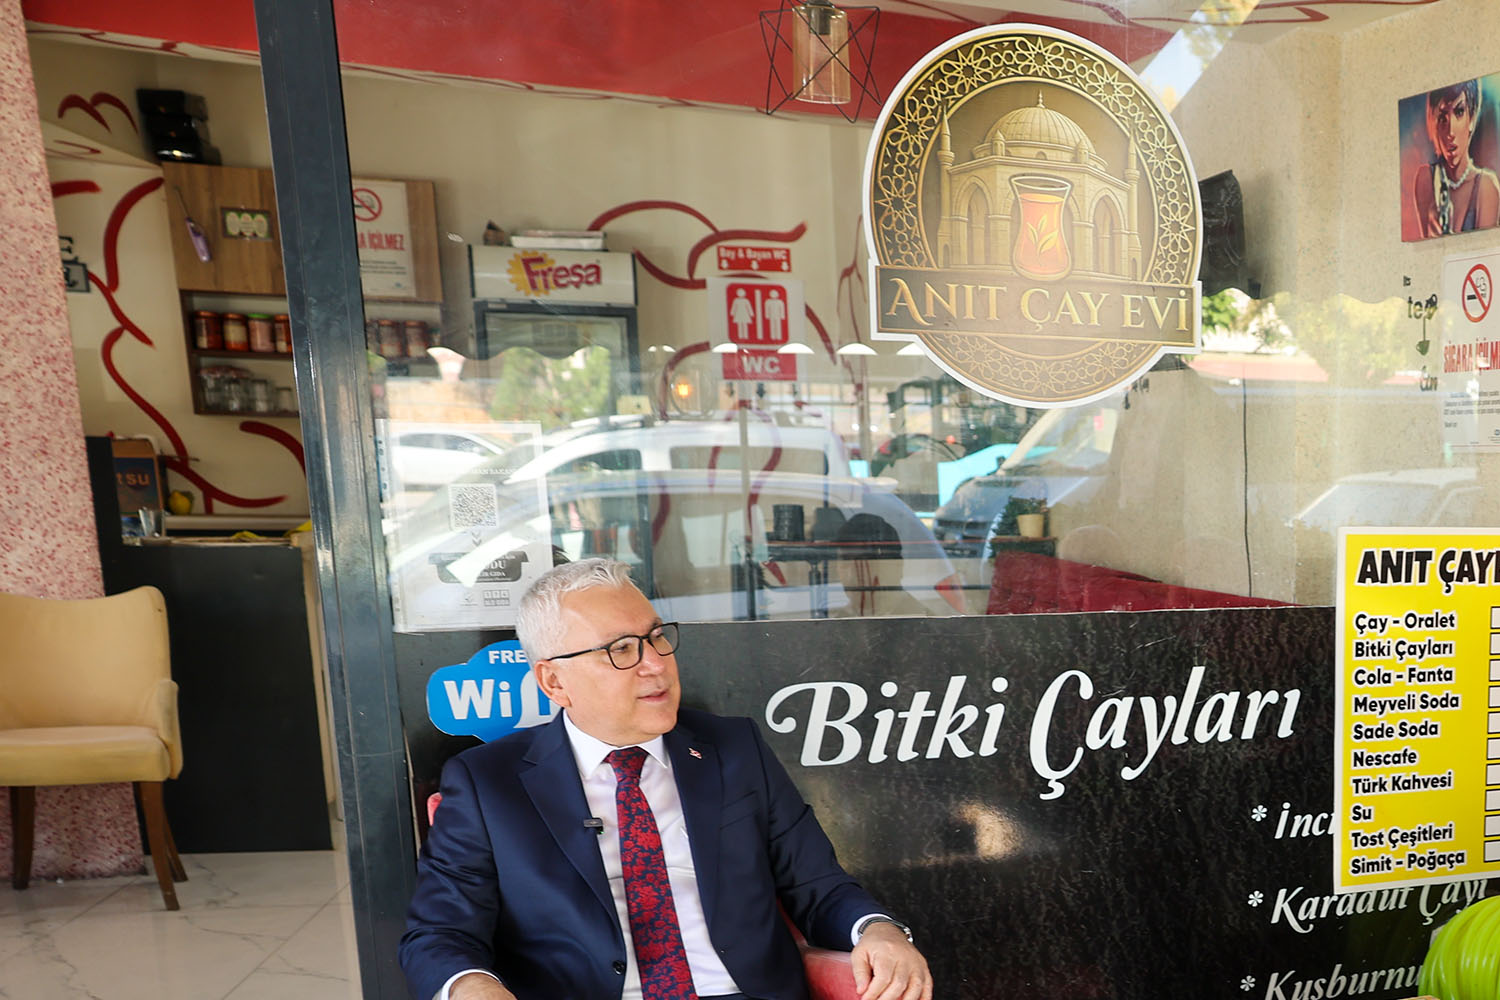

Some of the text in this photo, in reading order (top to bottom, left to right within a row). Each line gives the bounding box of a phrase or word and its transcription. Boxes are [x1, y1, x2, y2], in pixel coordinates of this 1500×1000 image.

[520, 256, 602, 290] Freşa
[885, 277, 1190, 332] ANIT ÇAY EVİ
[741, 355, 780, 374] WC
[1443, 340, 1474, 374] SİGARA
[1357, 550, 1433, 585] ANIT
[1355, 613, 1389, 635] Çay
[1404, 611, 1456, 629] Oralet
[1354, 638, 1453, 660] Bitki Çayları
[1354, 668, 1392, 686] Cola
[1408, 667, 1453, 683] Fanta
[1354, 692, 1459, 715] Meyveli Soda
[765, 665, 1301, 800] Bitki Çayları
[1353, 720, 1438, 741] Sade Soda
[1353, 748, 1417, 768] Nescafe
[1352, 771, 1452, 794] Türk Kahvesi
[1352, 804, 1372, 821] Su
[1351, 823, 1453, 849] Tost Çeşitleri
[1351, 855, 1392, 875] Simit
[1407, 851, 1465, 870] Poğaça
